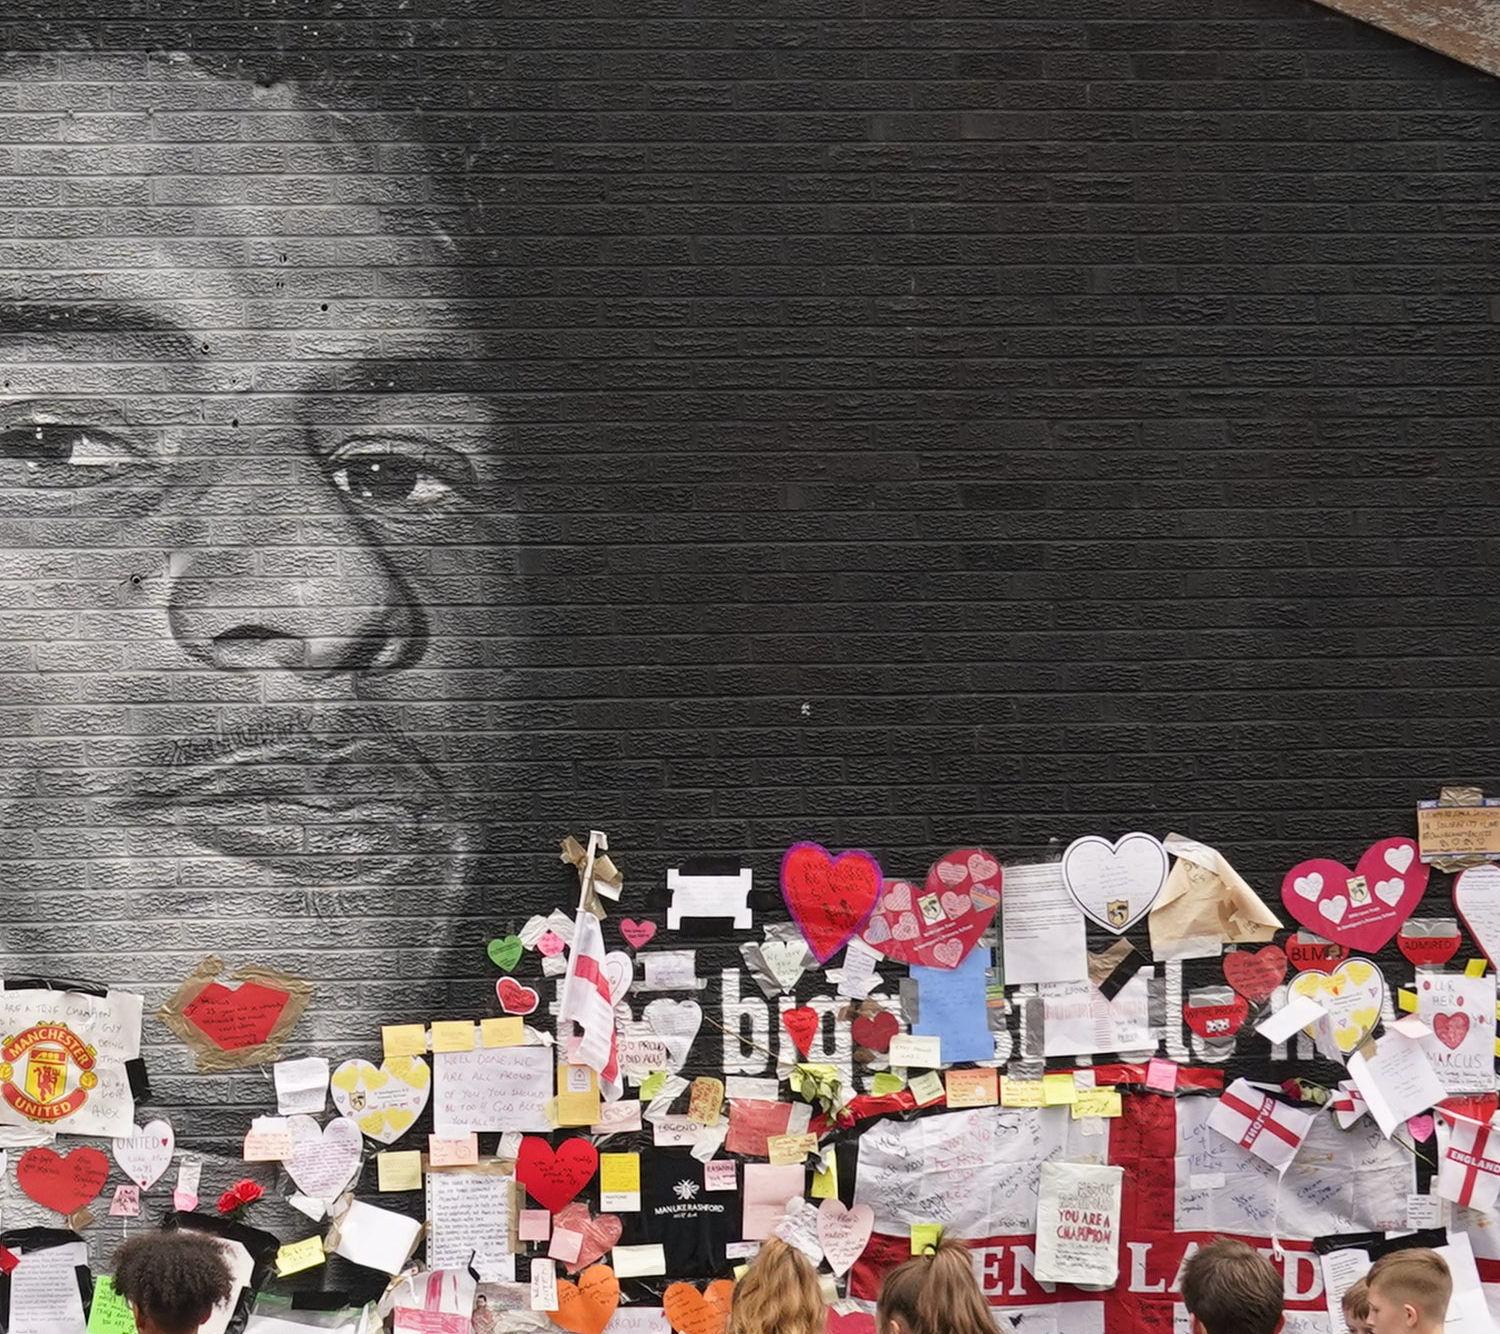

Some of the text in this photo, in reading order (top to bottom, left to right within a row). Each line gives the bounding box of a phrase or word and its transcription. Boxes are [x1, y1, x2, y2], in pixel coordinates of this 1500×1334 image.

[1292, 945, 1329, 962] BLM
[1403, 939, 1452, 952] ADMIRED
[9, 1028, 89, 1068] MANCHESTER
[15, 1097, 71, 1116] UNITED
[1058, 1209, 1110, 1228] YOU ARE A
[1057, 1225, 1112, 1245] CHAMPION
